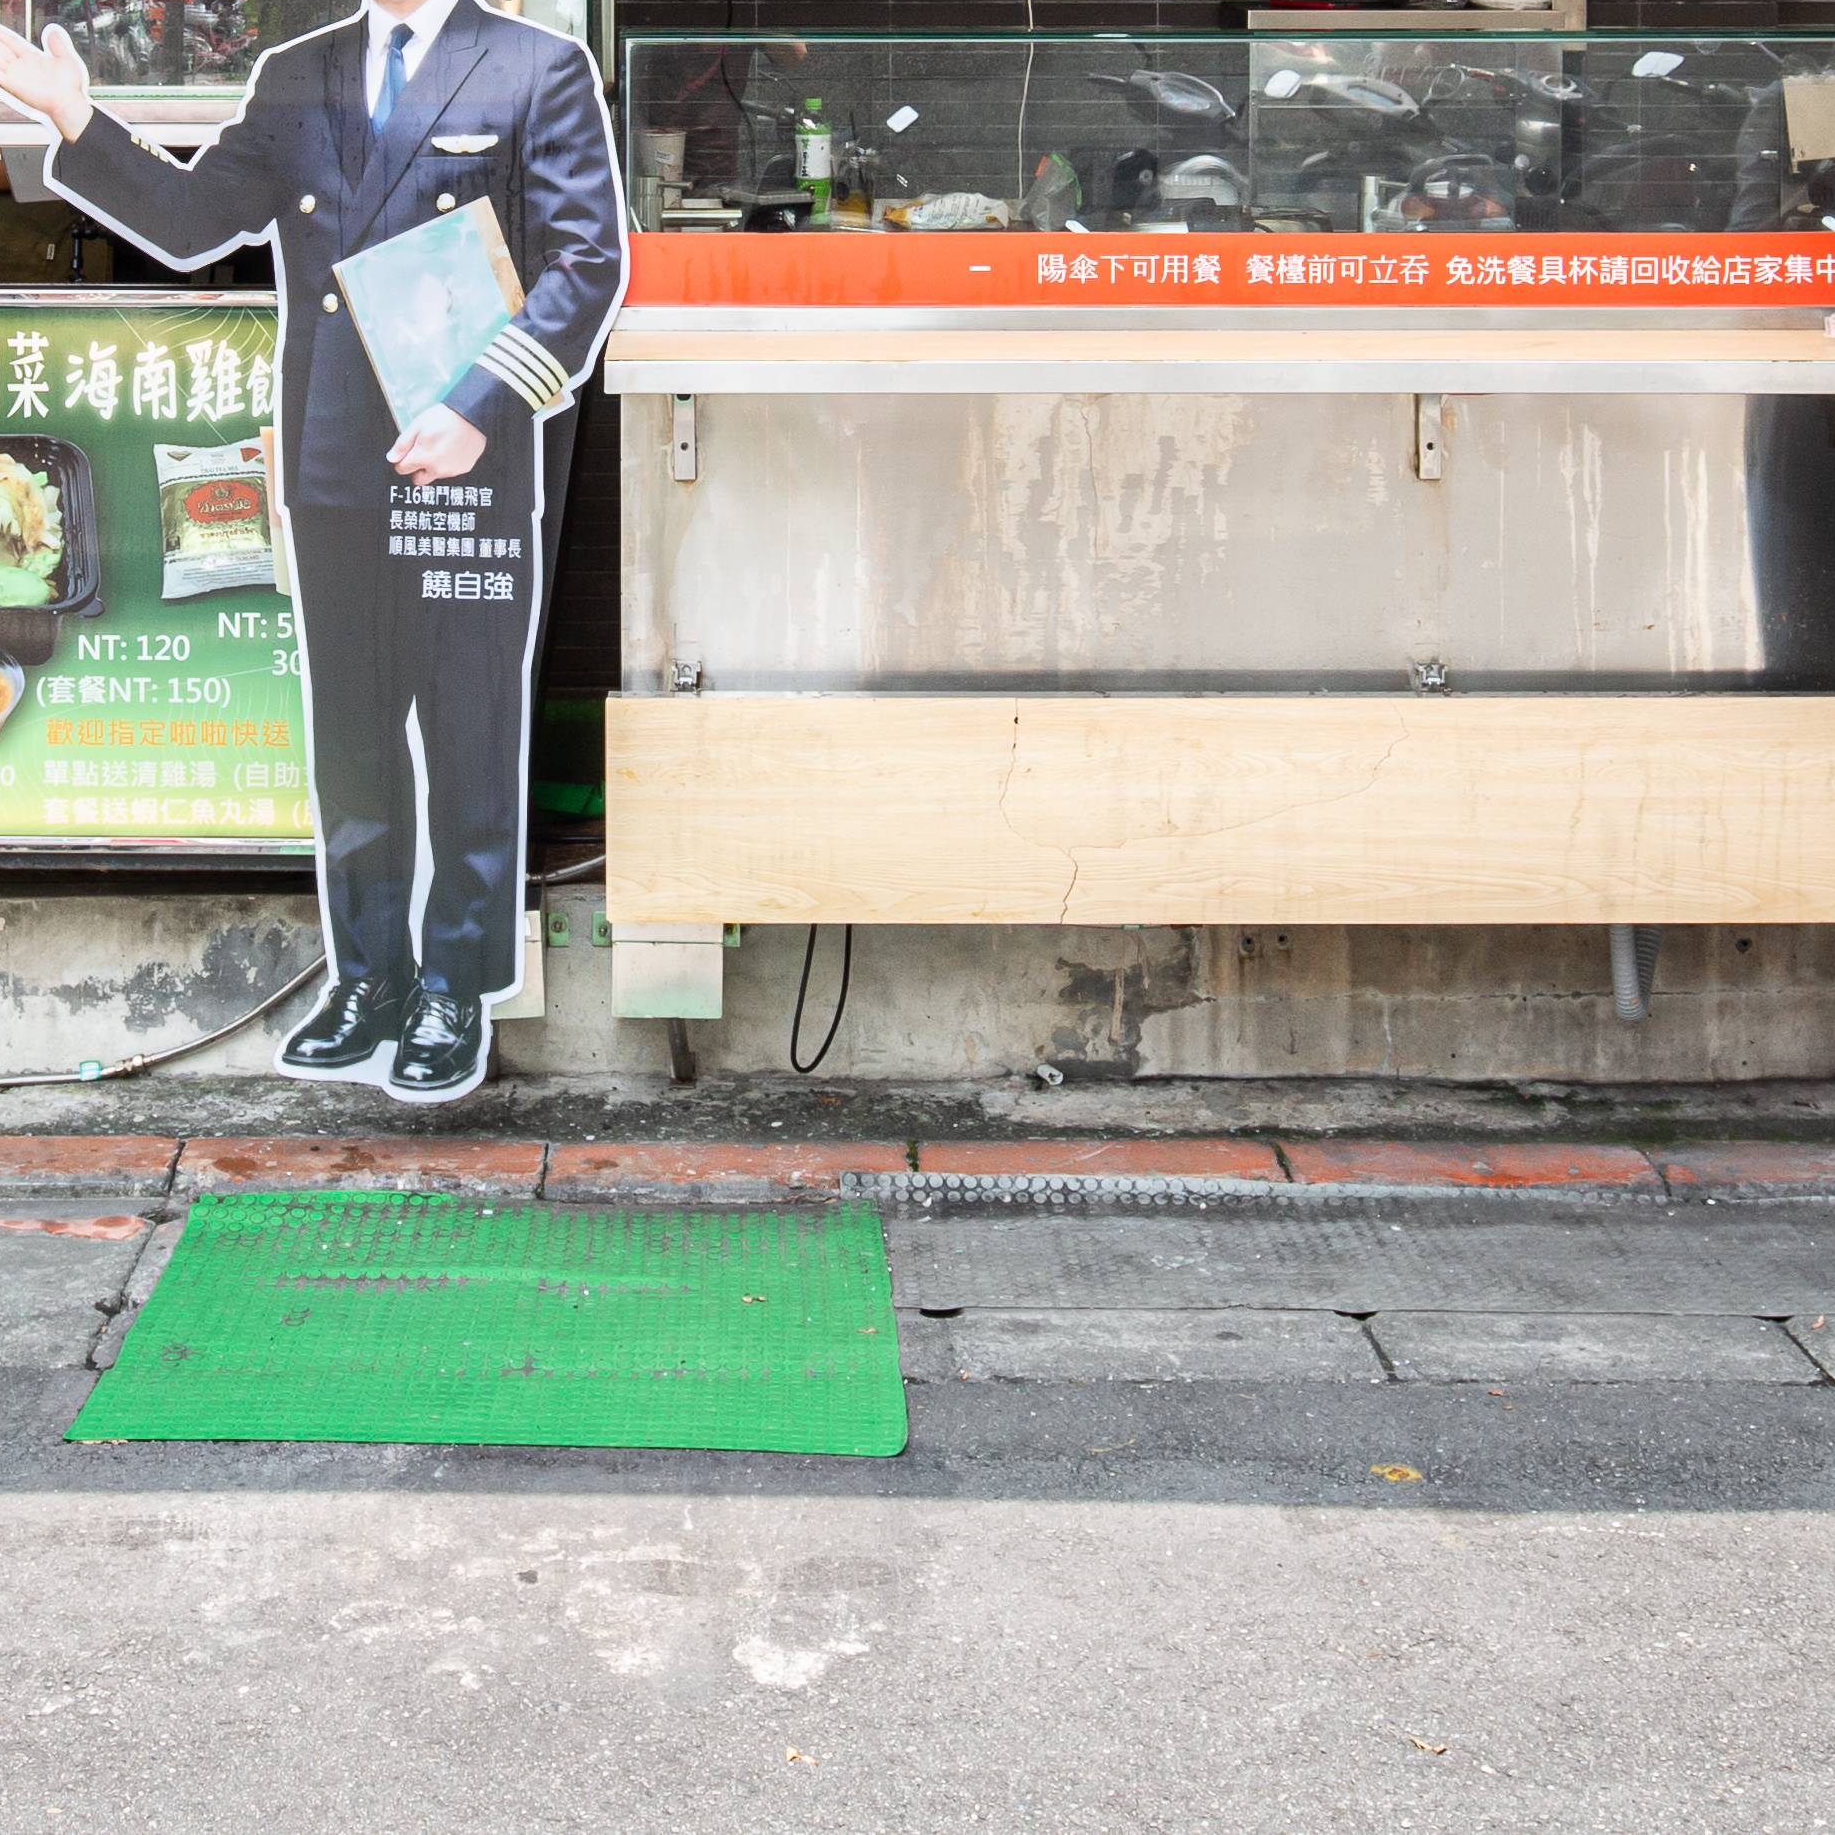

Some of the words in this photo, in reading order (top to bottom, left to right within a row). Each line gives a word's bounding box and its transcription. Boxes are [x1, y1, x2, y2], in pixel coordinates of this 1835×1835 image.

[1037, 253, 1221, 284] 陽傘下可用餐
[389, 510, 476, 532] 長榮航空機師
[479, 538, 522, 559] 董事長
[421, 569, 514, 601] 饒自強
[218, 612, 267, 638] NT:
[78, 635, 127, 660] NT:
[136, 635, 190, 661] 120
[167, 677, 231, 707] 150)
[45, 718, 290, 747] 歡迎指定啦啦快送
[42, 760, 216, 788] 單點送清雞湯
[42, 798, 275, 826] 套餐送蝦仁魚丸湯
